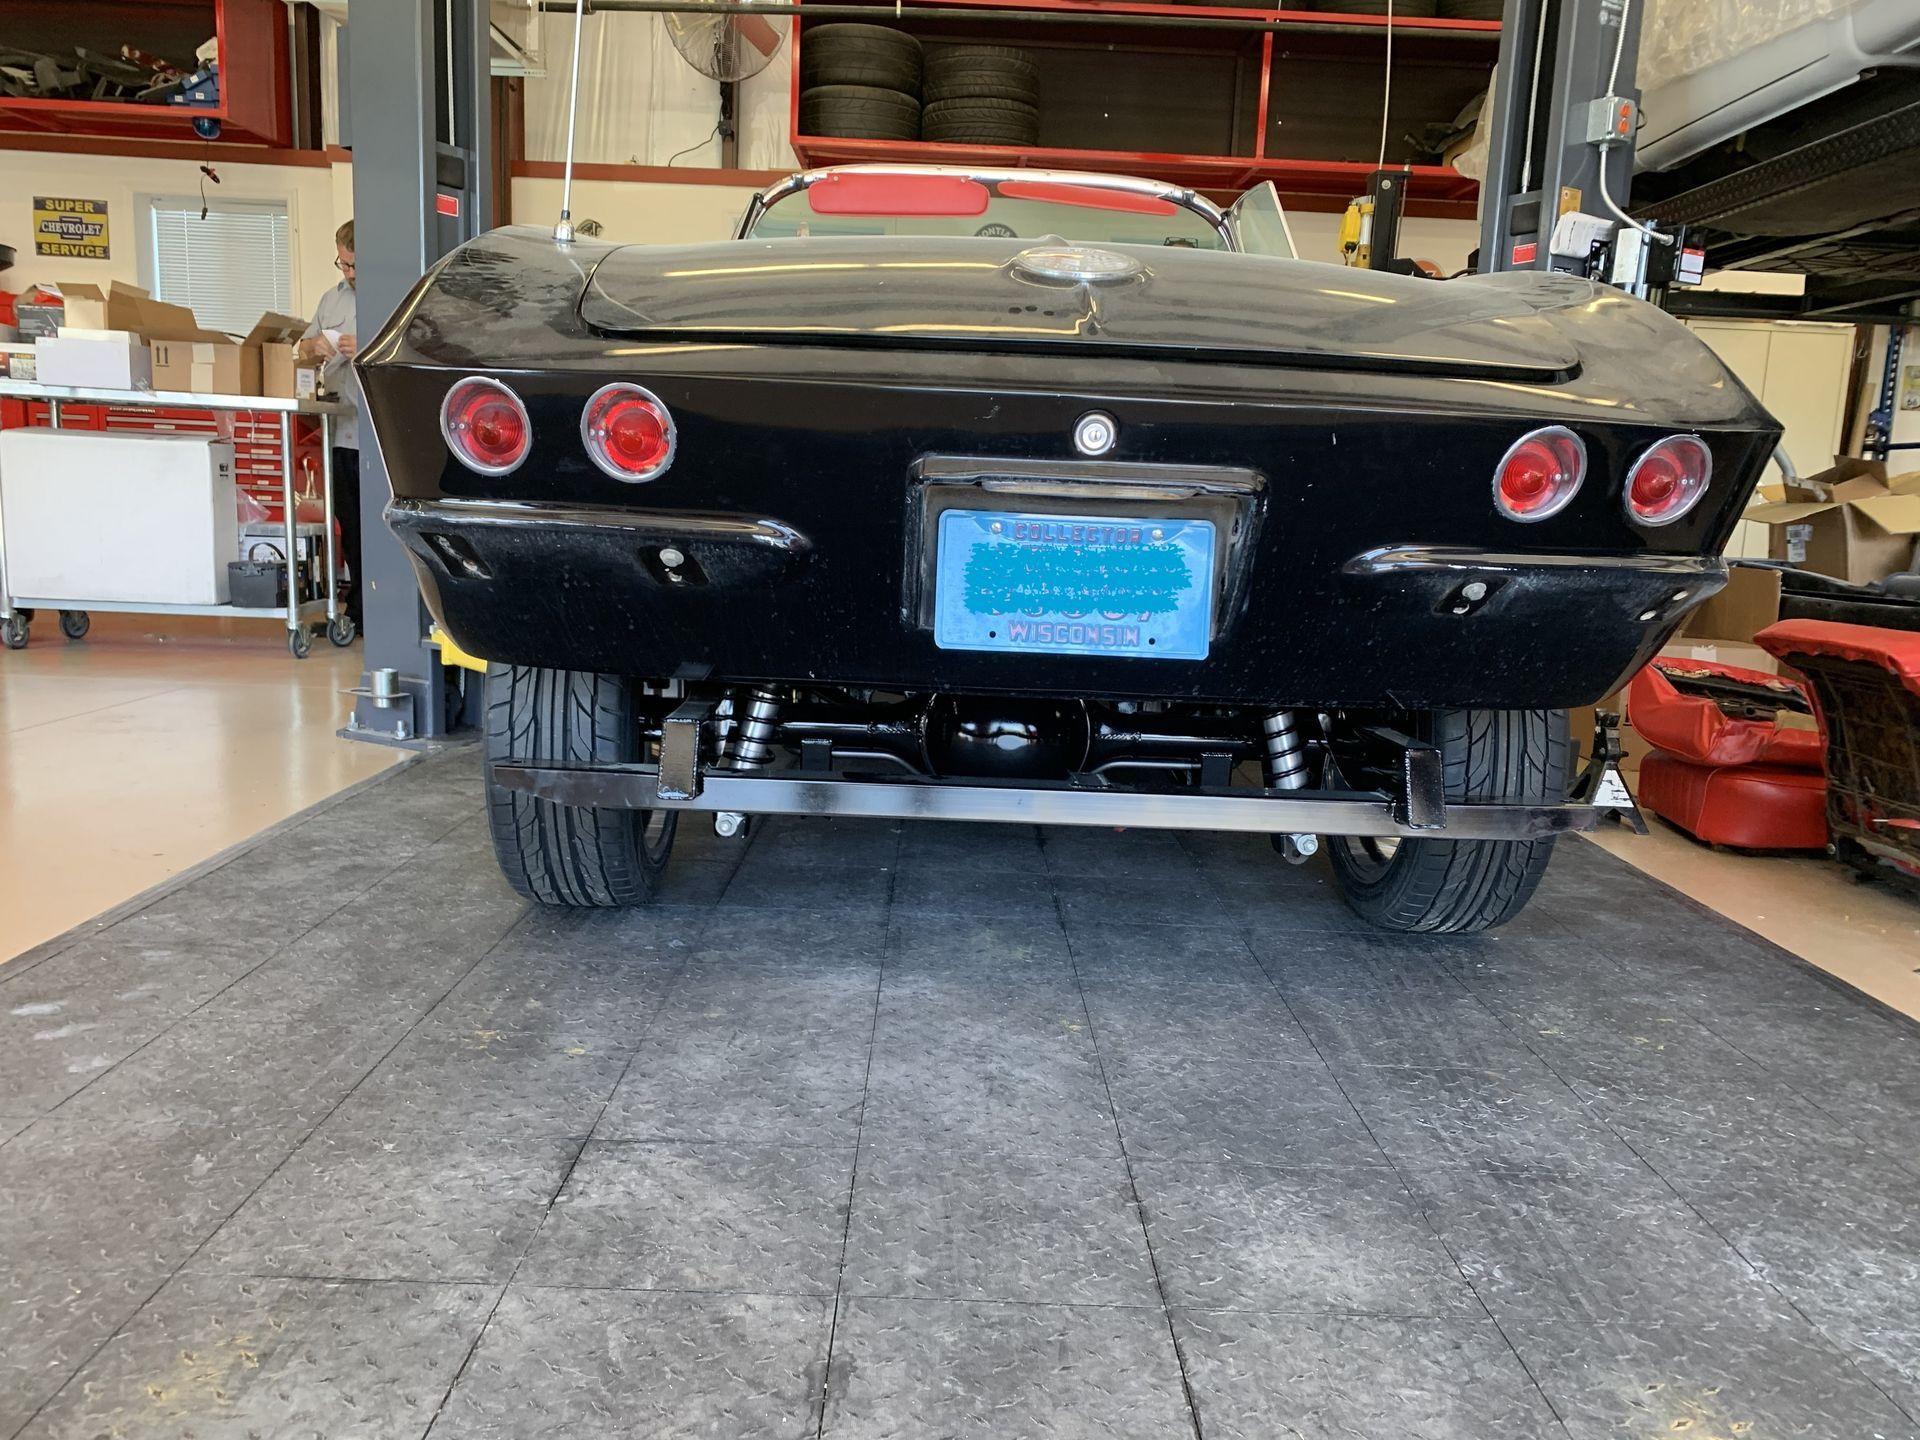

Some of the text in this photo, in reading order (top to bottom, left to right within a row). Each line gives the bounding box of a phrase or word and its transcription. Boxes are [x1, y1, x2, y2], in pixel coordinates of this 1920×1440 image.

[45, 200, 94, 212] SUPER
[41, 222, 101, 235] CHEVROLET
[981, 226, 1010, 237] ONTIA
[41, 243, 104, 257] SERVICE
[1014, 522, 1143, 544] COLLECTOR
[1008, 620, 1141, 647] WISCONSIN
